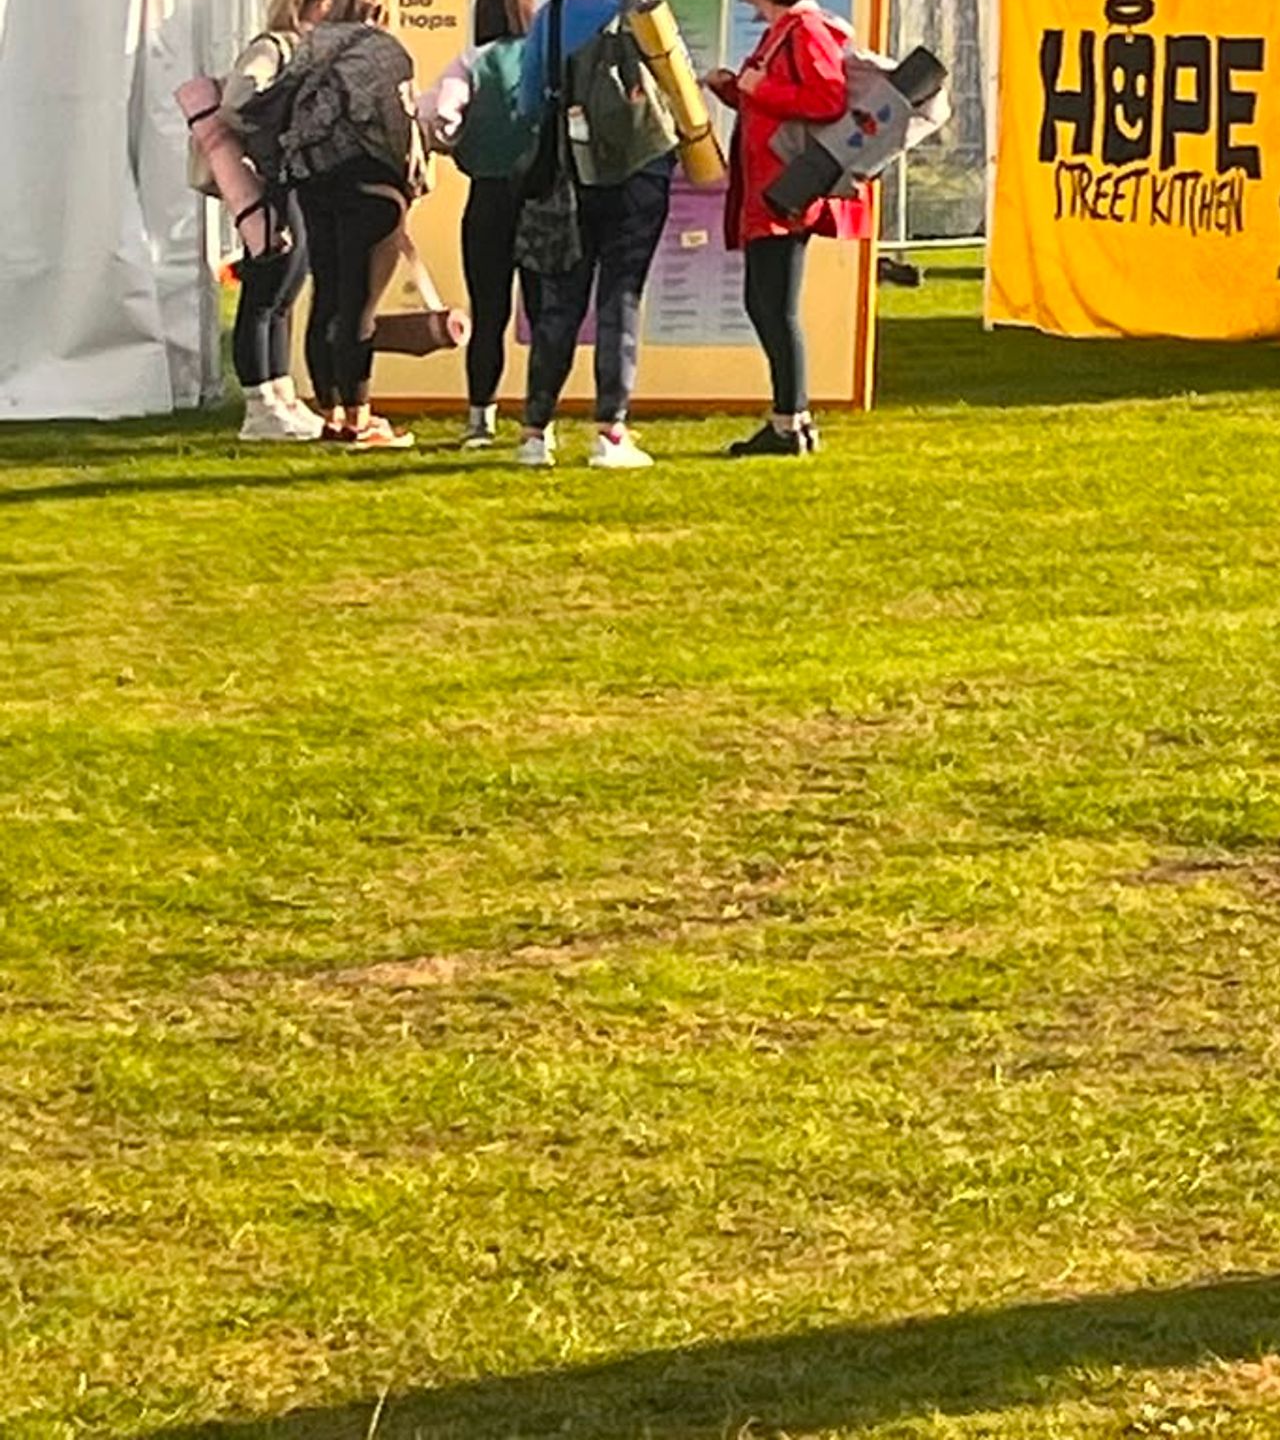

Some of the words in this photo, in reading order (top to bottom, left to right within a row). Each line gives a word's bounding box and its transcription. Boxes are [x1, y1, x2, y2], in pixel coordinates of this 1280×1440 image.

[1039, 28, 1265, 180] HOPE
[1054, 160, 1149, 222] STREET
[1150, 168, 1244, 237] KITCHEN
